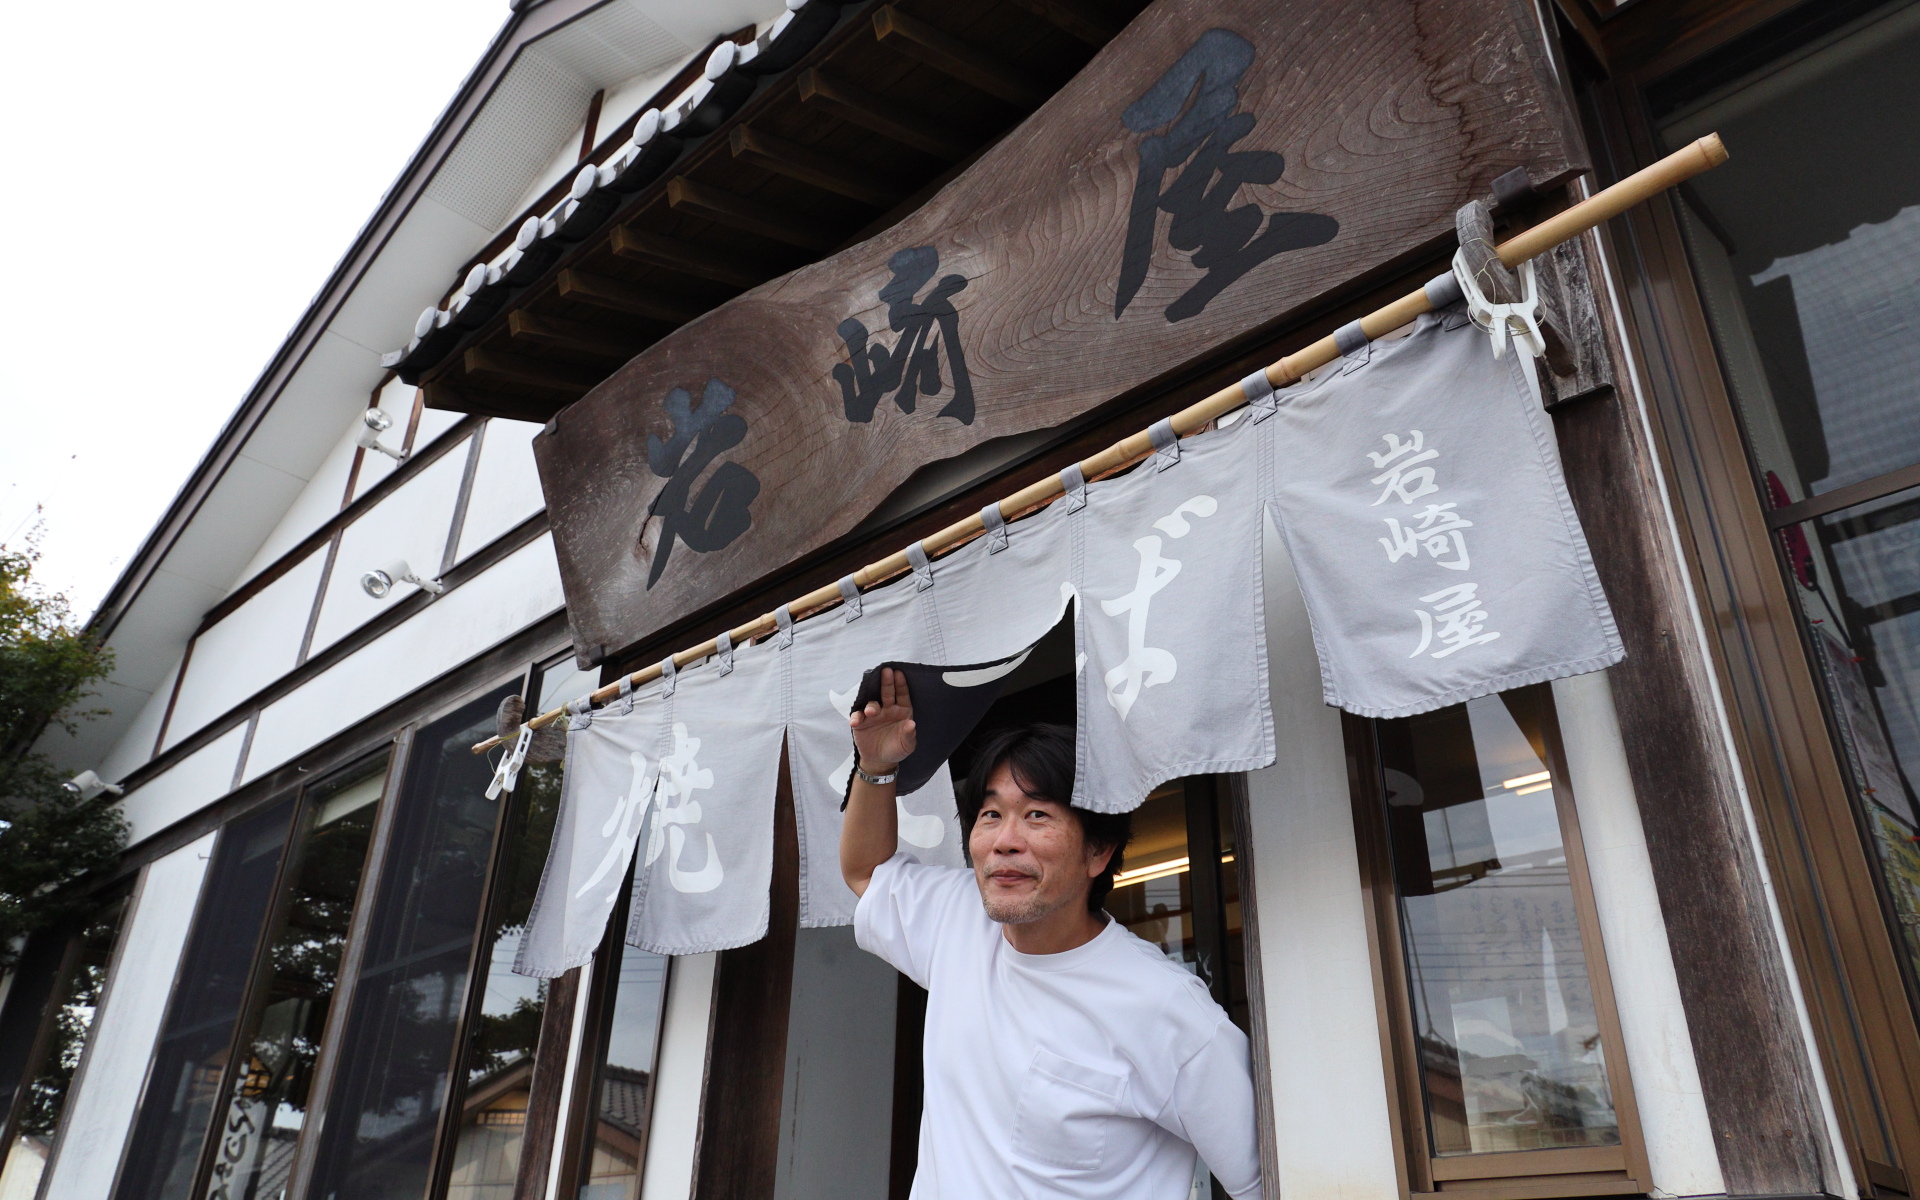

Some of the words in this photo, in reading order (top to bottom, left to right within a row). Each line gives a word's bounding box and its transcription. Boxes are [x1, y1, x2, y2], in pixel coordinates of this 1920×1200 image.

[647, 27, 1339, 591] 岩崎屋
[1367, 429, 1501, 659] 岩崎屋
